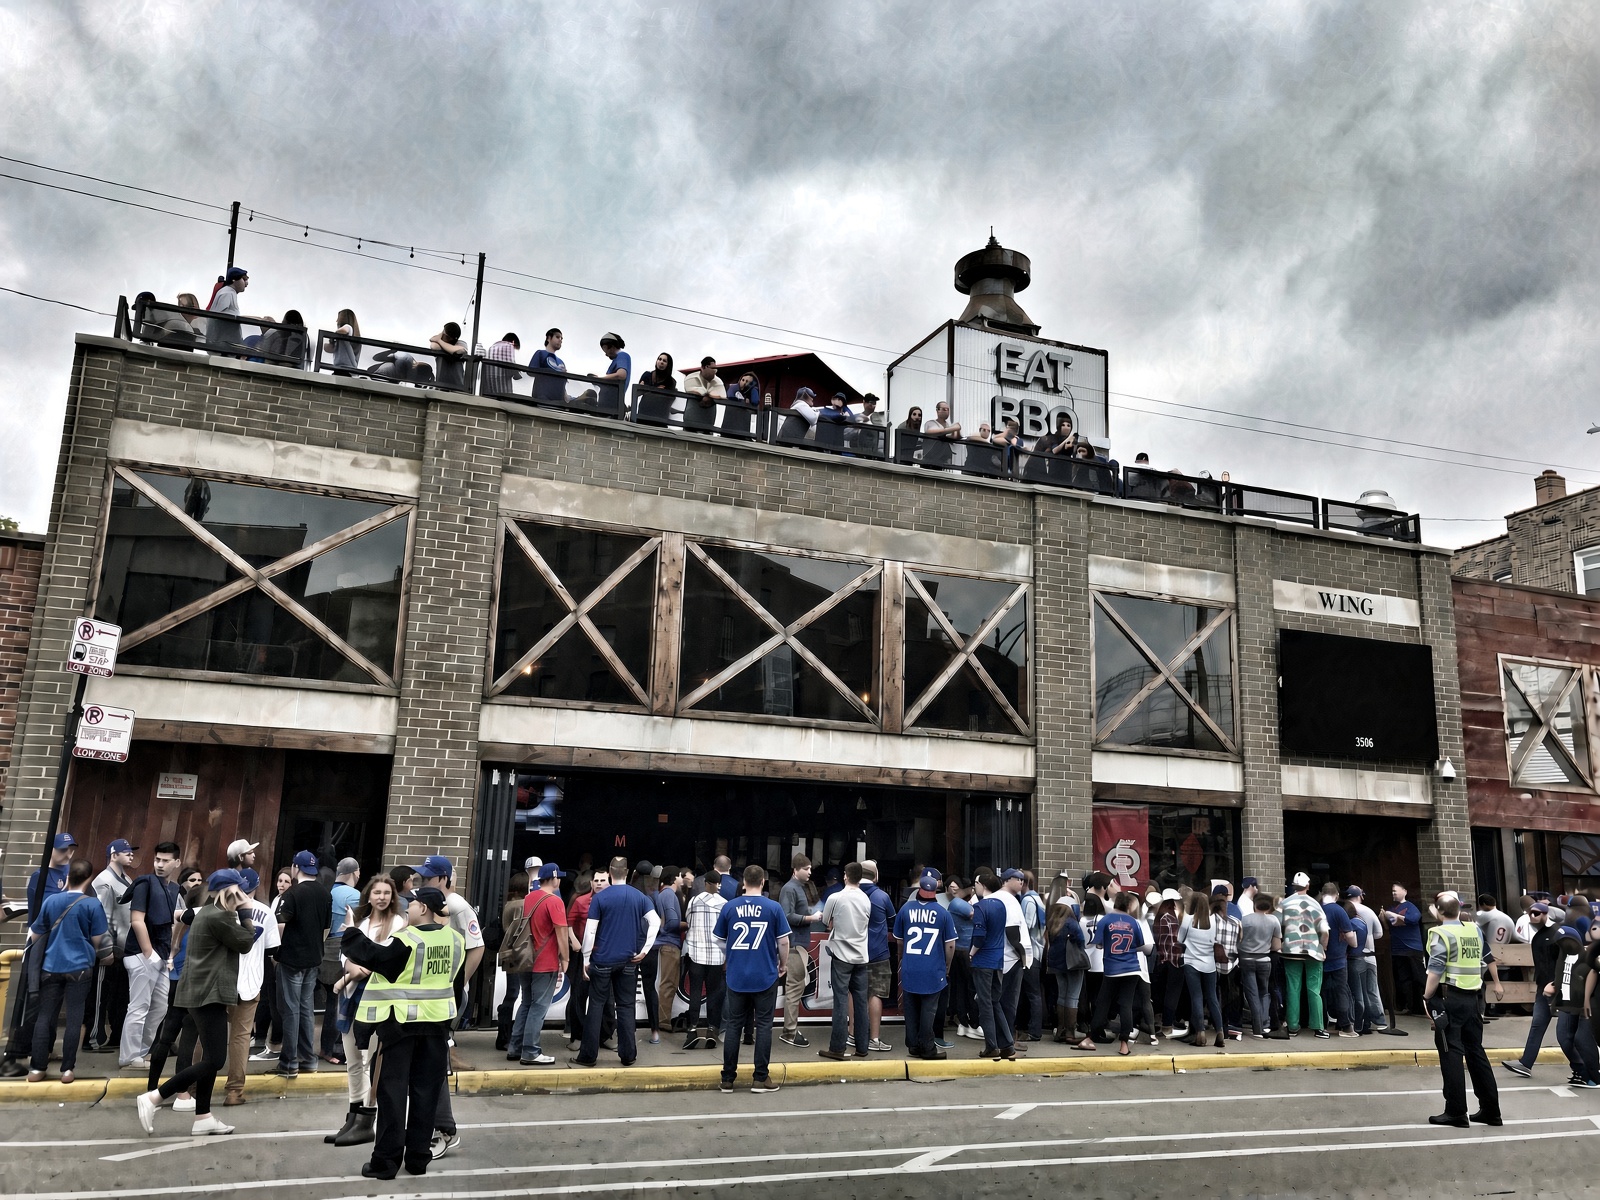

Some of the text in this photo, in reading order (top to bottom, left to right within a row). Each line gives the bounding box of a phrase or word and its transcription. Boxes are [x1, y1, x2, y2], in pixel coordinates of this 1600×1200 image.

[995, 342, 1073, 393] EAT
[1318, 591, 1374, 616] WING
[88, 666, 111, 676] ZONE
[1355, 736, 1374, 748] 3506
[77, 749, 122, 761] LOW ZONE
[735, 904, 762, 918] WING
[908, 908, 938, 925] WING
[730, 921, 769, 950] 27
[905, 926, 940, 956] 27
[1495, 927, 1507, 942] 9
[1110, 933, 1134, 955] 27
[426, 959, 451, 975] POLICE
